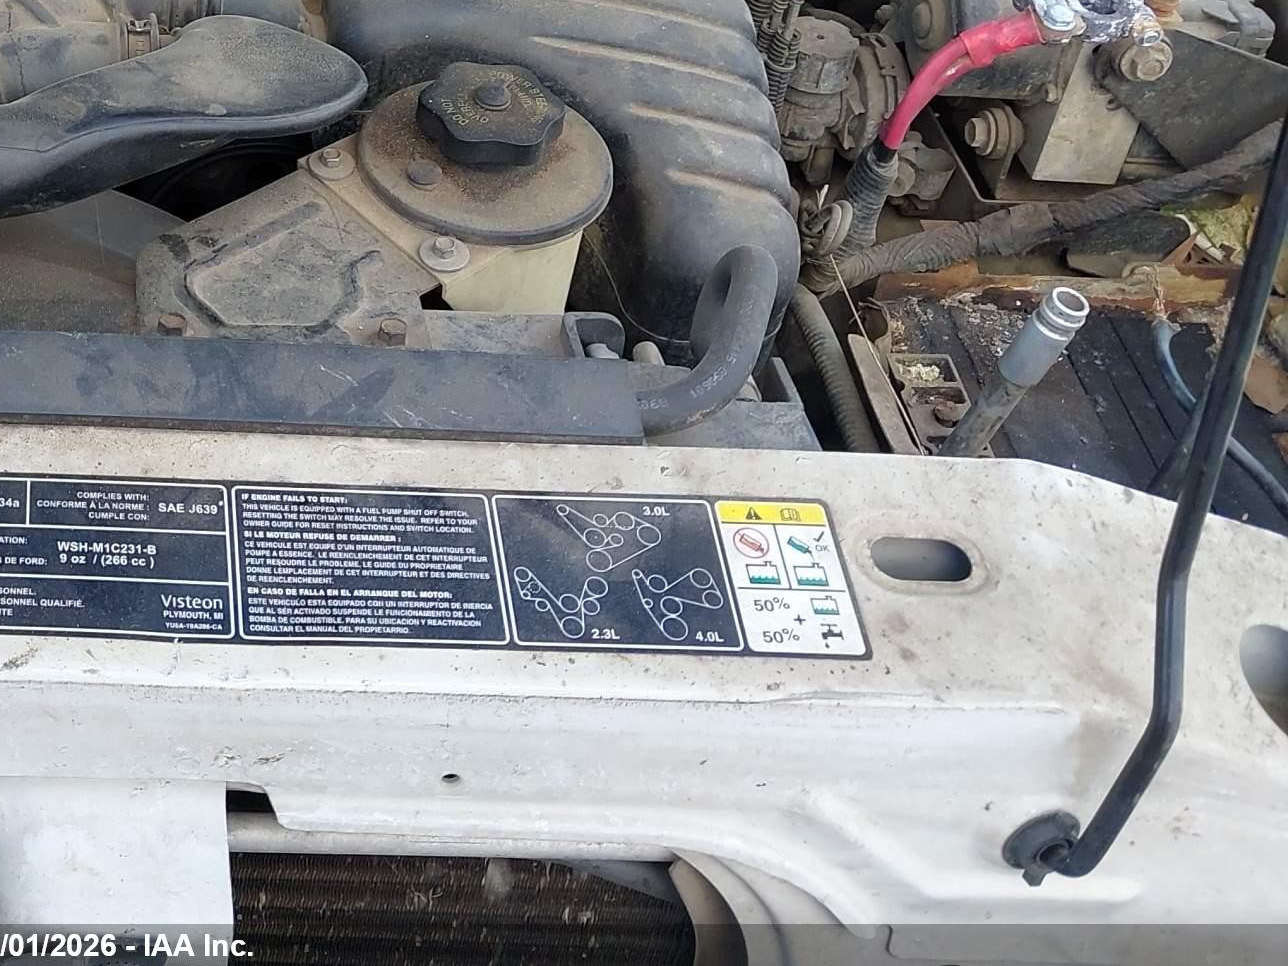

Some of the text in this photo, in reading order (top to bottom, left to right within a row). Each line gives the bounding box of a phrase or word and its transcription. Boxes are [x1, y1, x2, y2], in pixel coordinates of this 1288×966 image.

[76, 492, 149, 501] COMPLIES WITH:
[241, 493, 347, 504] IF ENGINE FAILS TO START:
[36, 500, 86, 509] CONFORME
[112, 502, 144, 510] NORME
[157, 502, 217, 514] SAE J639
[641, 505, 670, 516] 3.0L
[88, 511, 149, 520] CUMPLE CON:
[57, 541, 156, 554] WSH-M1C231-B
[4, 557, 16, 565] DE
[19, 557, 48, 566] FORD:
[59, 553, 66, 563] 9
[160, 594, 223, 609] Visteon
[751, 596, 792, 613] 50%
[213, 611, 223, 620] MI
[590, 628, 621, 640] 2.3L
[694, 631, 725, 643] 4.0L
[760, 627, 802, 644] 50%
